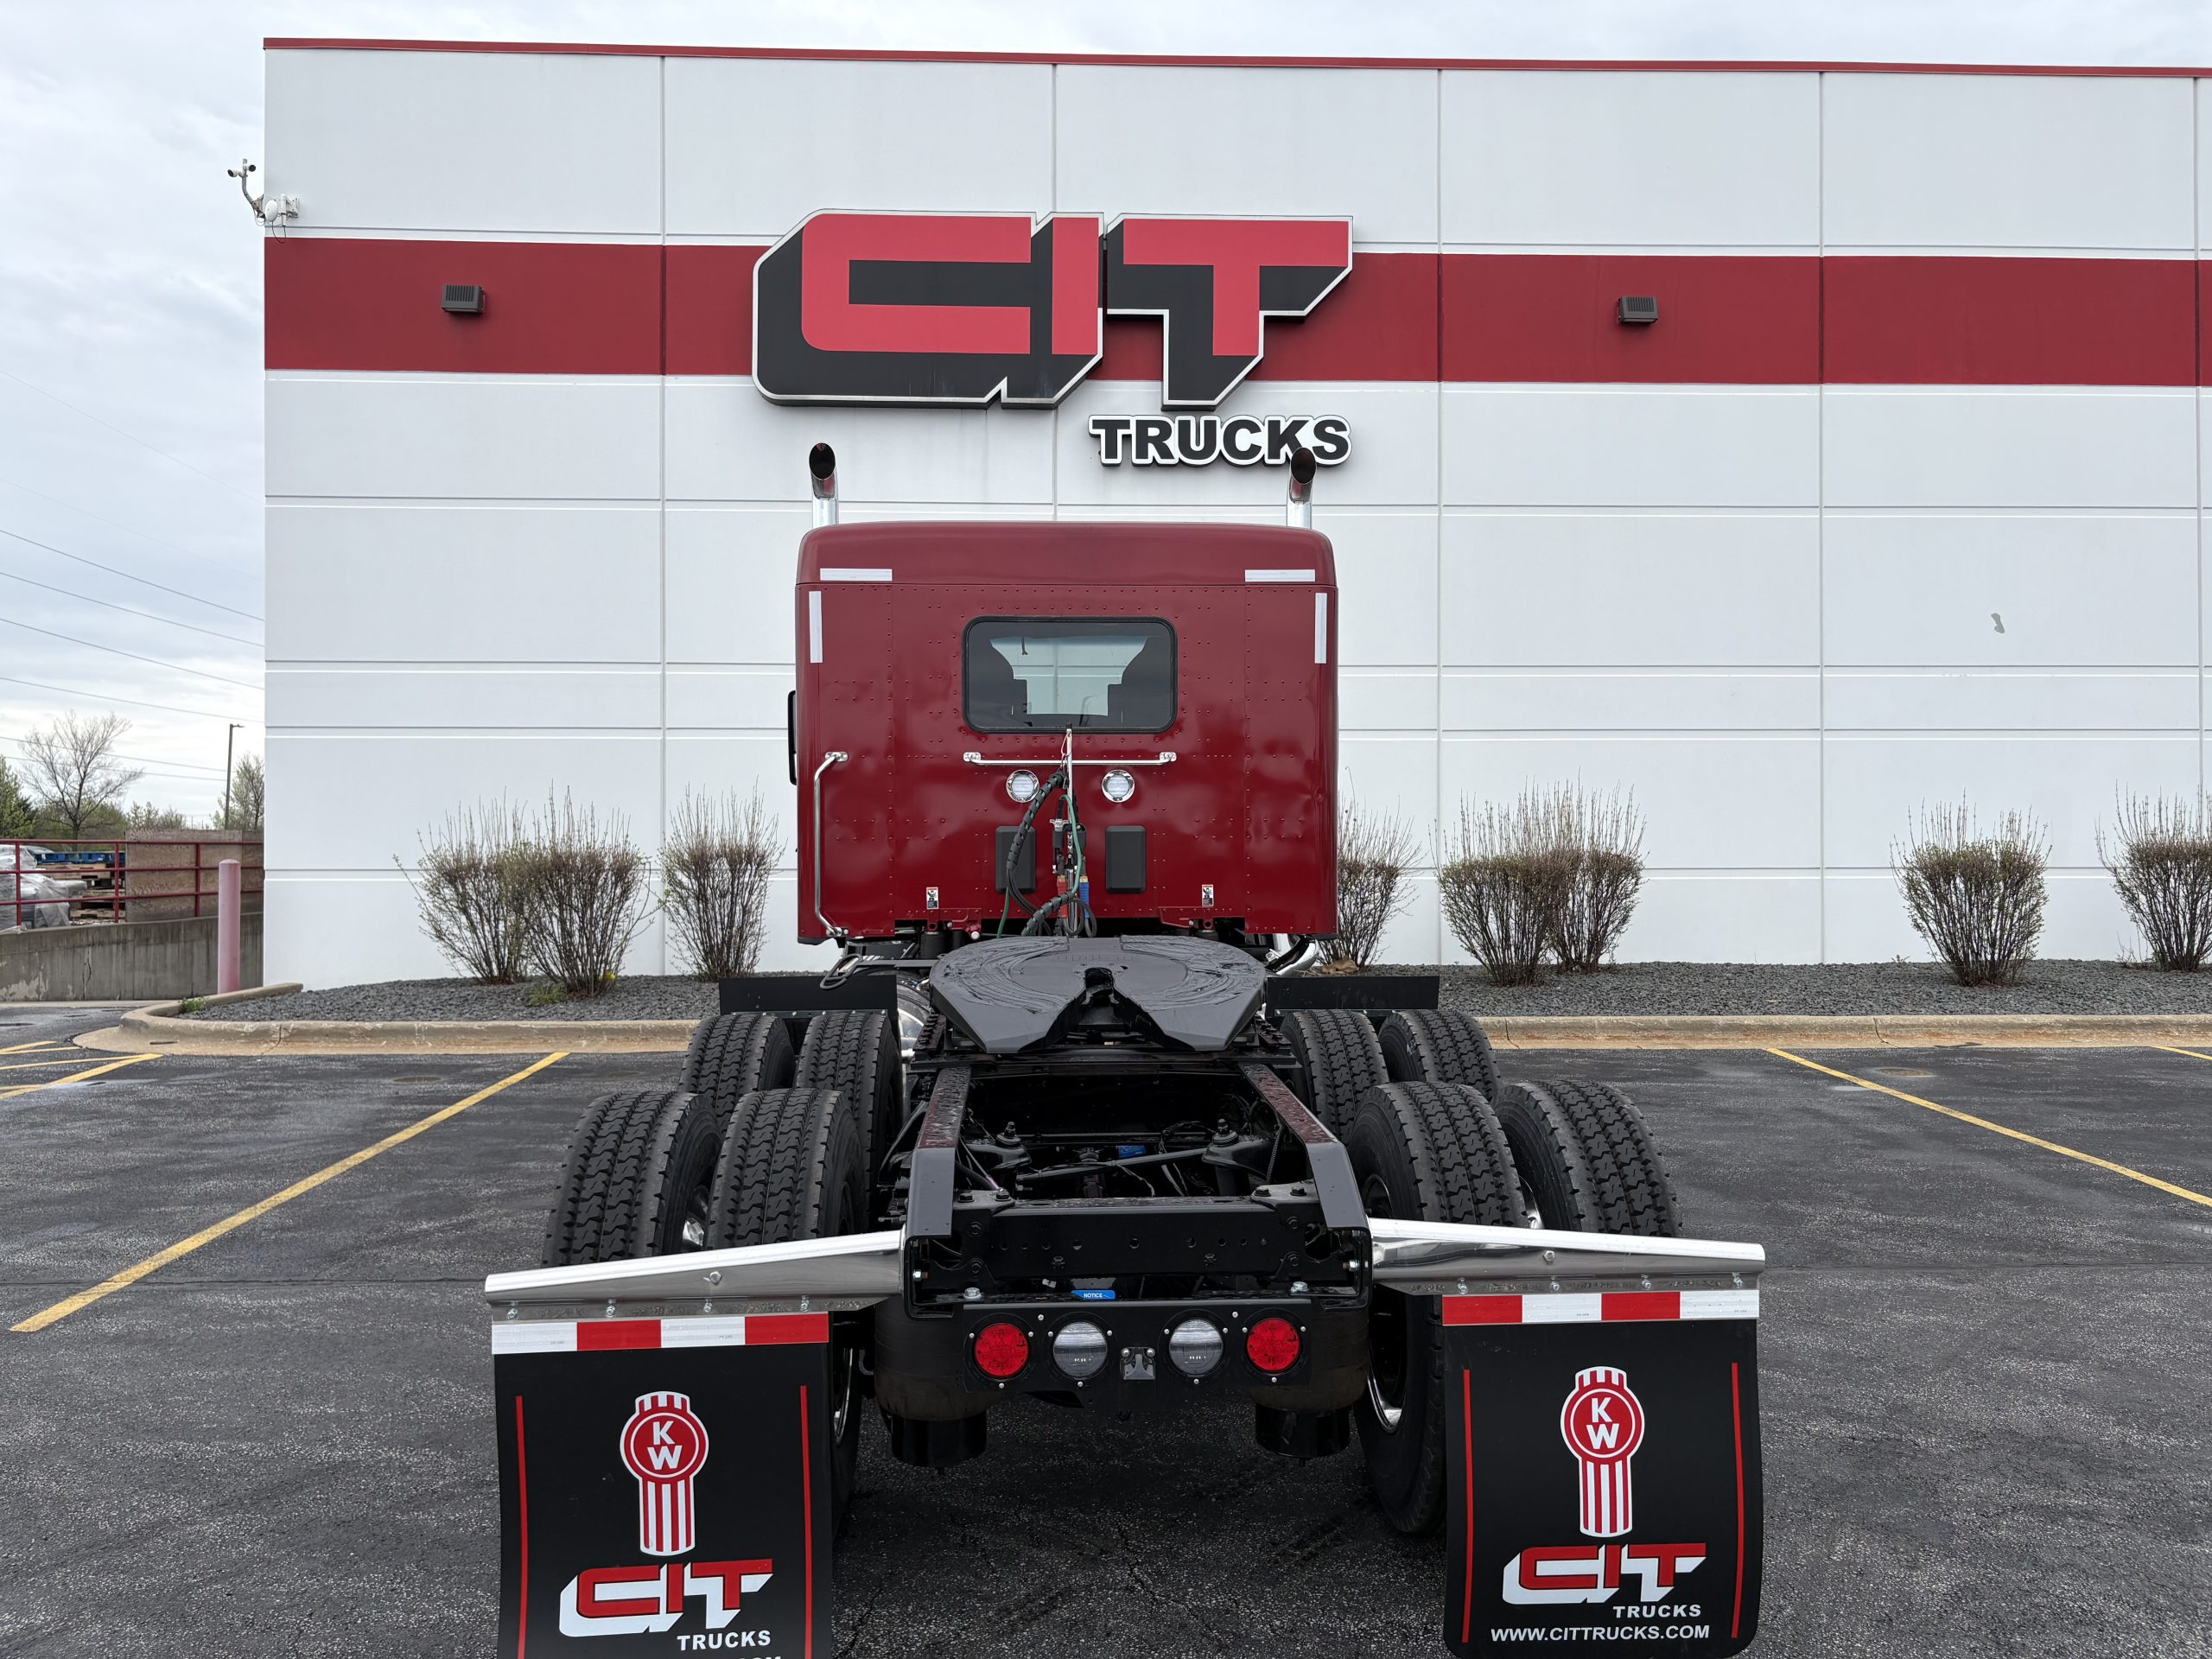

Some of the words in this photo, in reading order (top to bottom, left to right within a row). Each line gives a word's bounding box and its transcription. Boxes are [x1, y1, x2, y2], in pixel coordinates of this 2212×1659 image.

[756, 213, 1351, 403] CIT
[1092, 419, 1349, 461] TRUCKS
[1503, 1543, 1707, 1605] CIT
[559, 1559, 773, 1637] CIT
[1613, 1604, 1701, 1618] TRUCKS
[677, 1630, 771, 1650] TRUCKS
[1491, 1624, 1710, 1641] WWW.CITTRUCKS.COM
